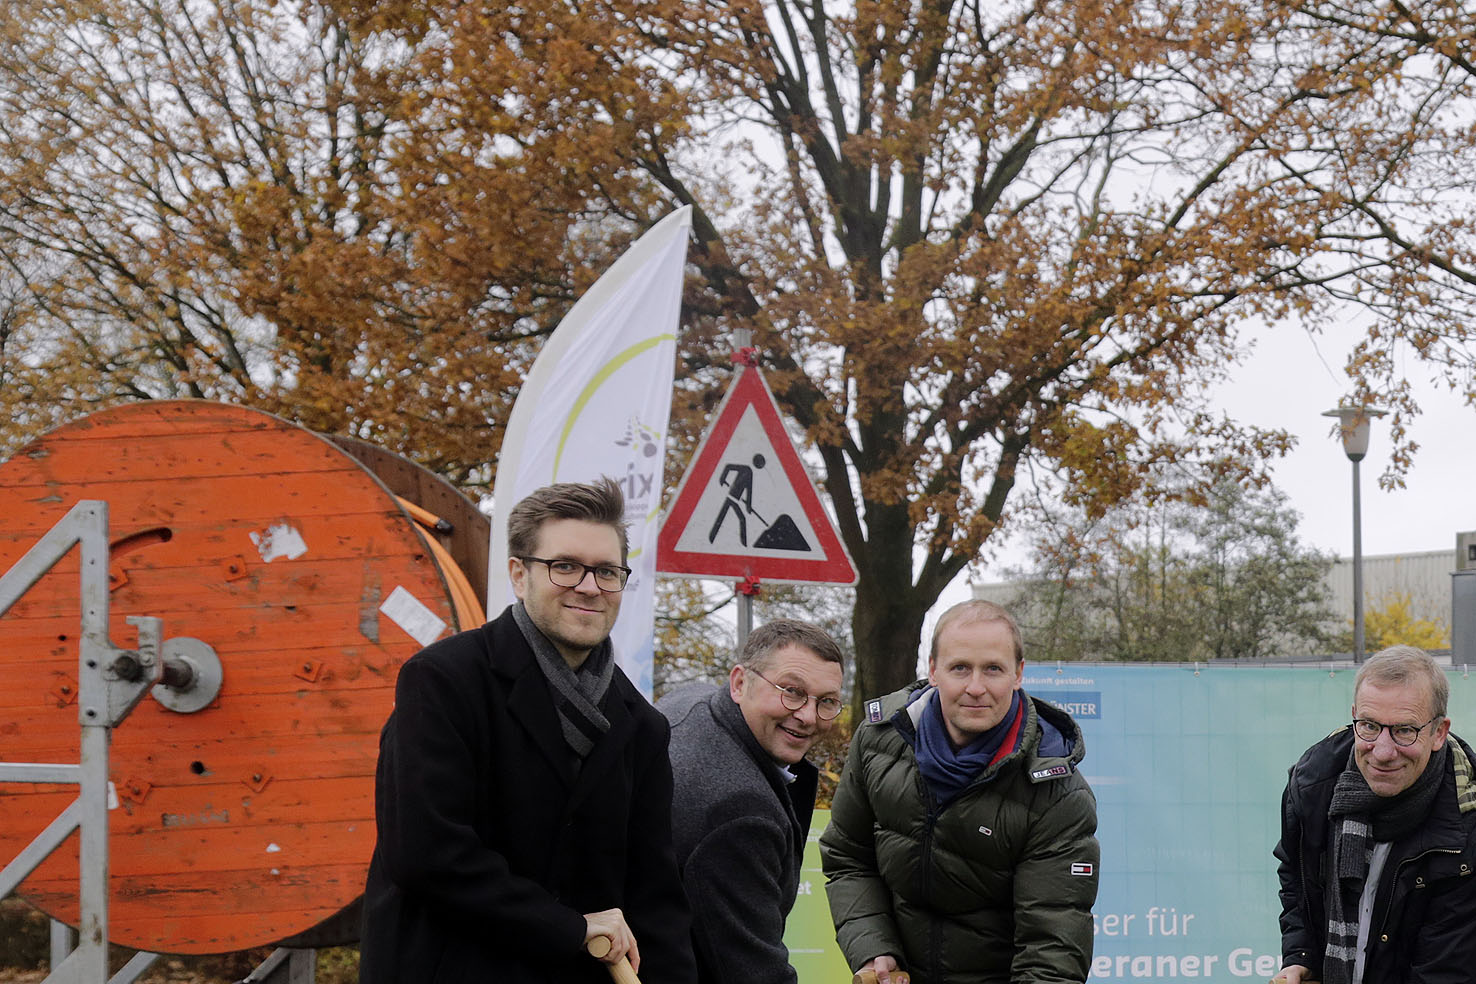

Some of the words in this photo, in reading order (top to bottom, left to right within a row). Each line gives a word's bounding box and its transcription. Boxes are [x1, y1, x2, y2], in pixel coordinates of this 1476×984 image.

[1050, 701, 1097, 715] NSTER
[1145, 906, 1195, 937] für
[1089, 953, 1219, 978] eraner
